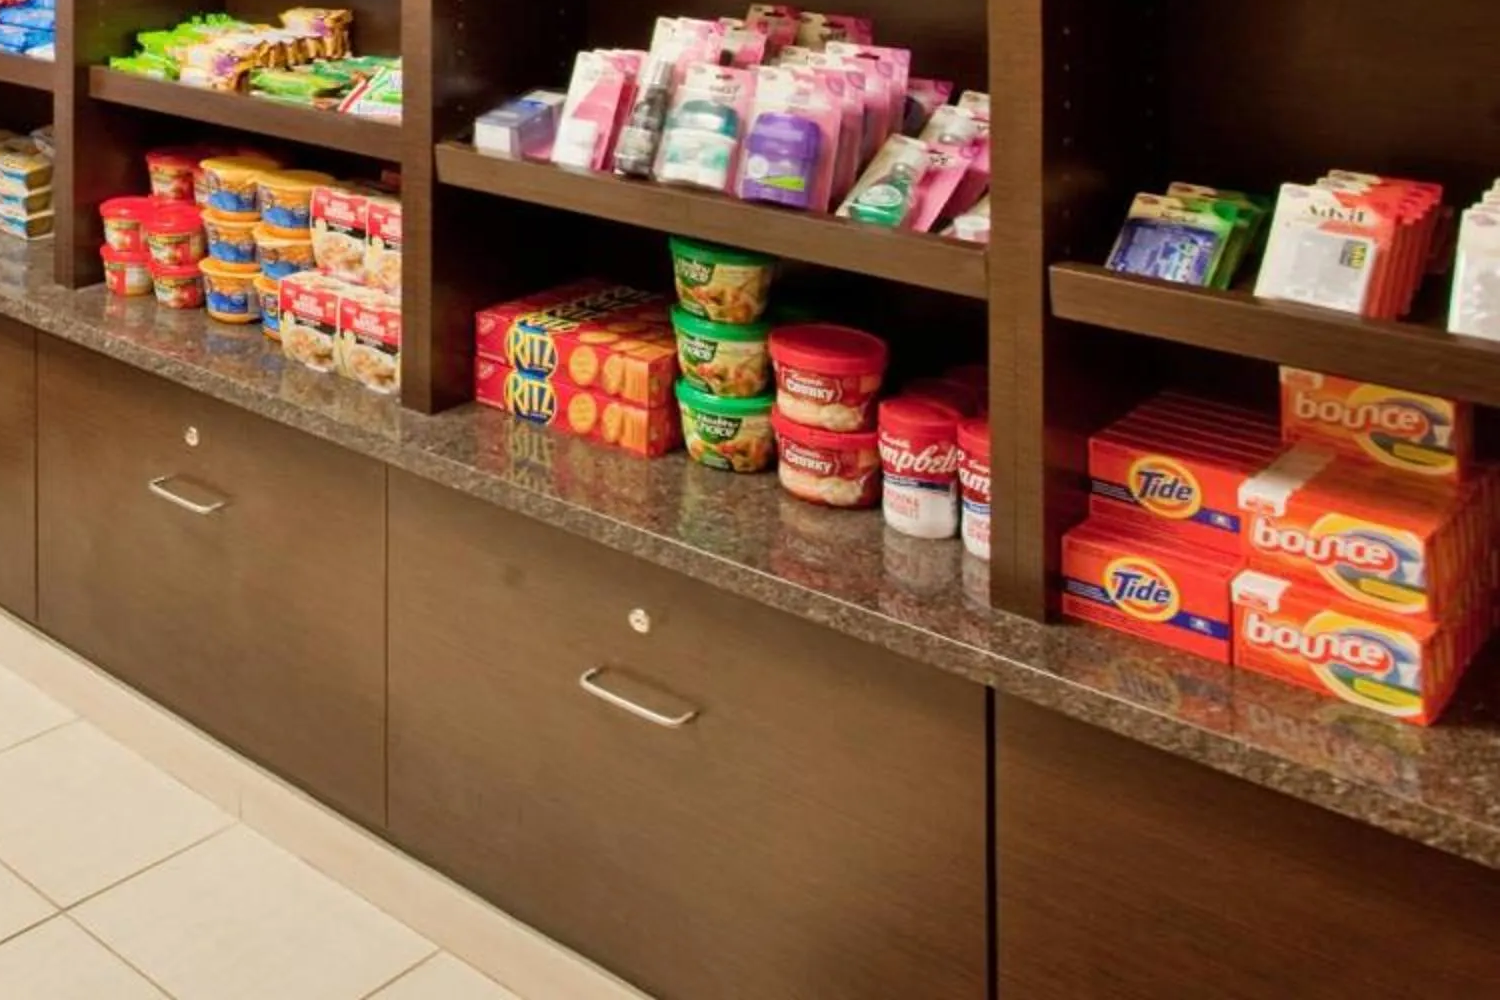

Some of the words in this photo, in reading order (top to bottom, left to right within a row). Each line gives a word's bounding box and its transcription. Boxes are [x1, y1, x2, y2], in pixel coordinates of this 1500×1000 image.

[1308, 204, 1365, 223] Advil
[510, 328, 555, 374] RITZ
[509, 375, 555, 419] RITZ
[1294, 392, 1422, 430] bounce
[1137, 470, 1194, 501] Tide
[1252, 517, 1392, 569] bounce
[1112, 571, 1171, 604] Tide
[1247, 613, 1387, 666] bounce
